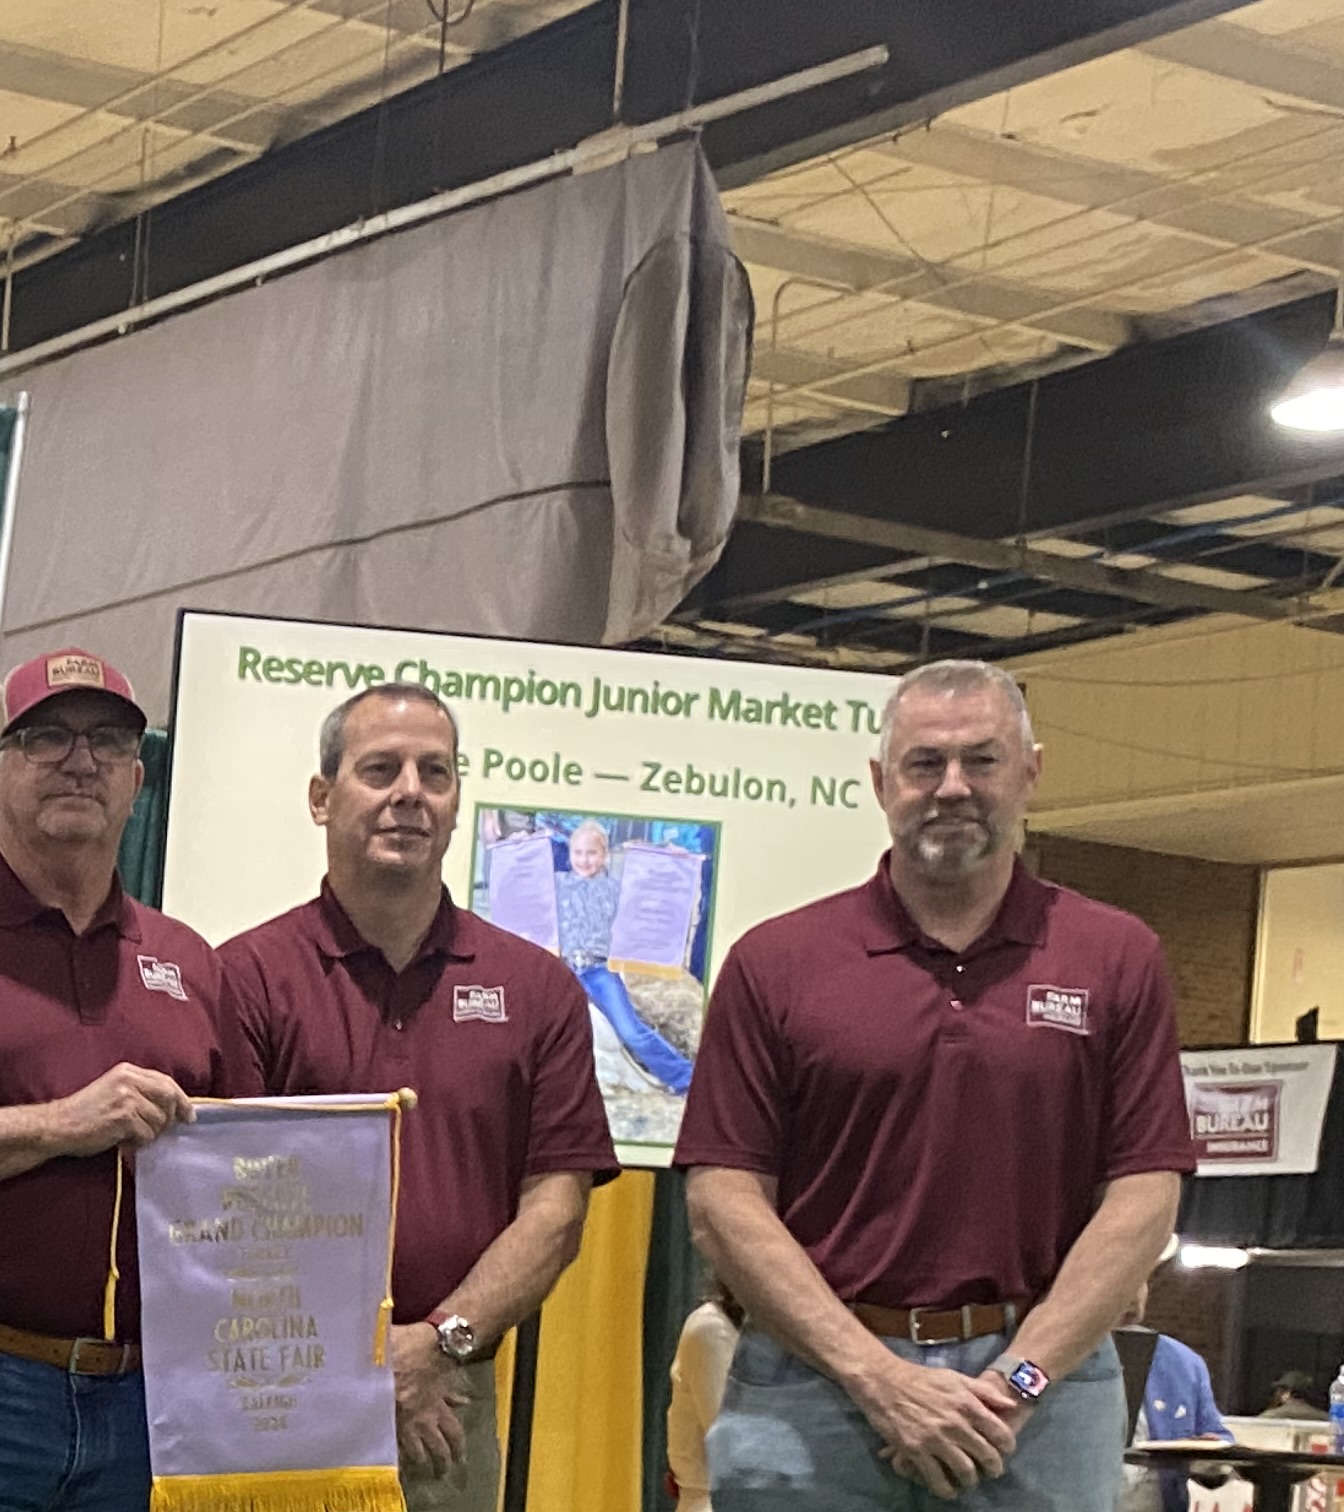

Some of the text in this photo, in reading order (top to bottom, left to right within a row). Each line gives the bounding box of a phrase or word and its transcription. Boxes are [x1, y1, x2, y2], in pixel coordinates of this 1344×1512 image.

[238, 646, 385, 688] Reserve
[395, 660, 581, 711] Champion
[585, 677, 699, 718] Junior
[708, 687, 838, 730] Market
[482, 748, 582, 784] Poole
[640, 761, 796, 807] Zebulon,
[811, 776, 861, 808] NC
[169, 1214, 363, 1246] GRAND CHAMPION
[214, 1314, 318, 1343] CAROLINA
[207, 1344, 327, 1373] STATE FAIR
